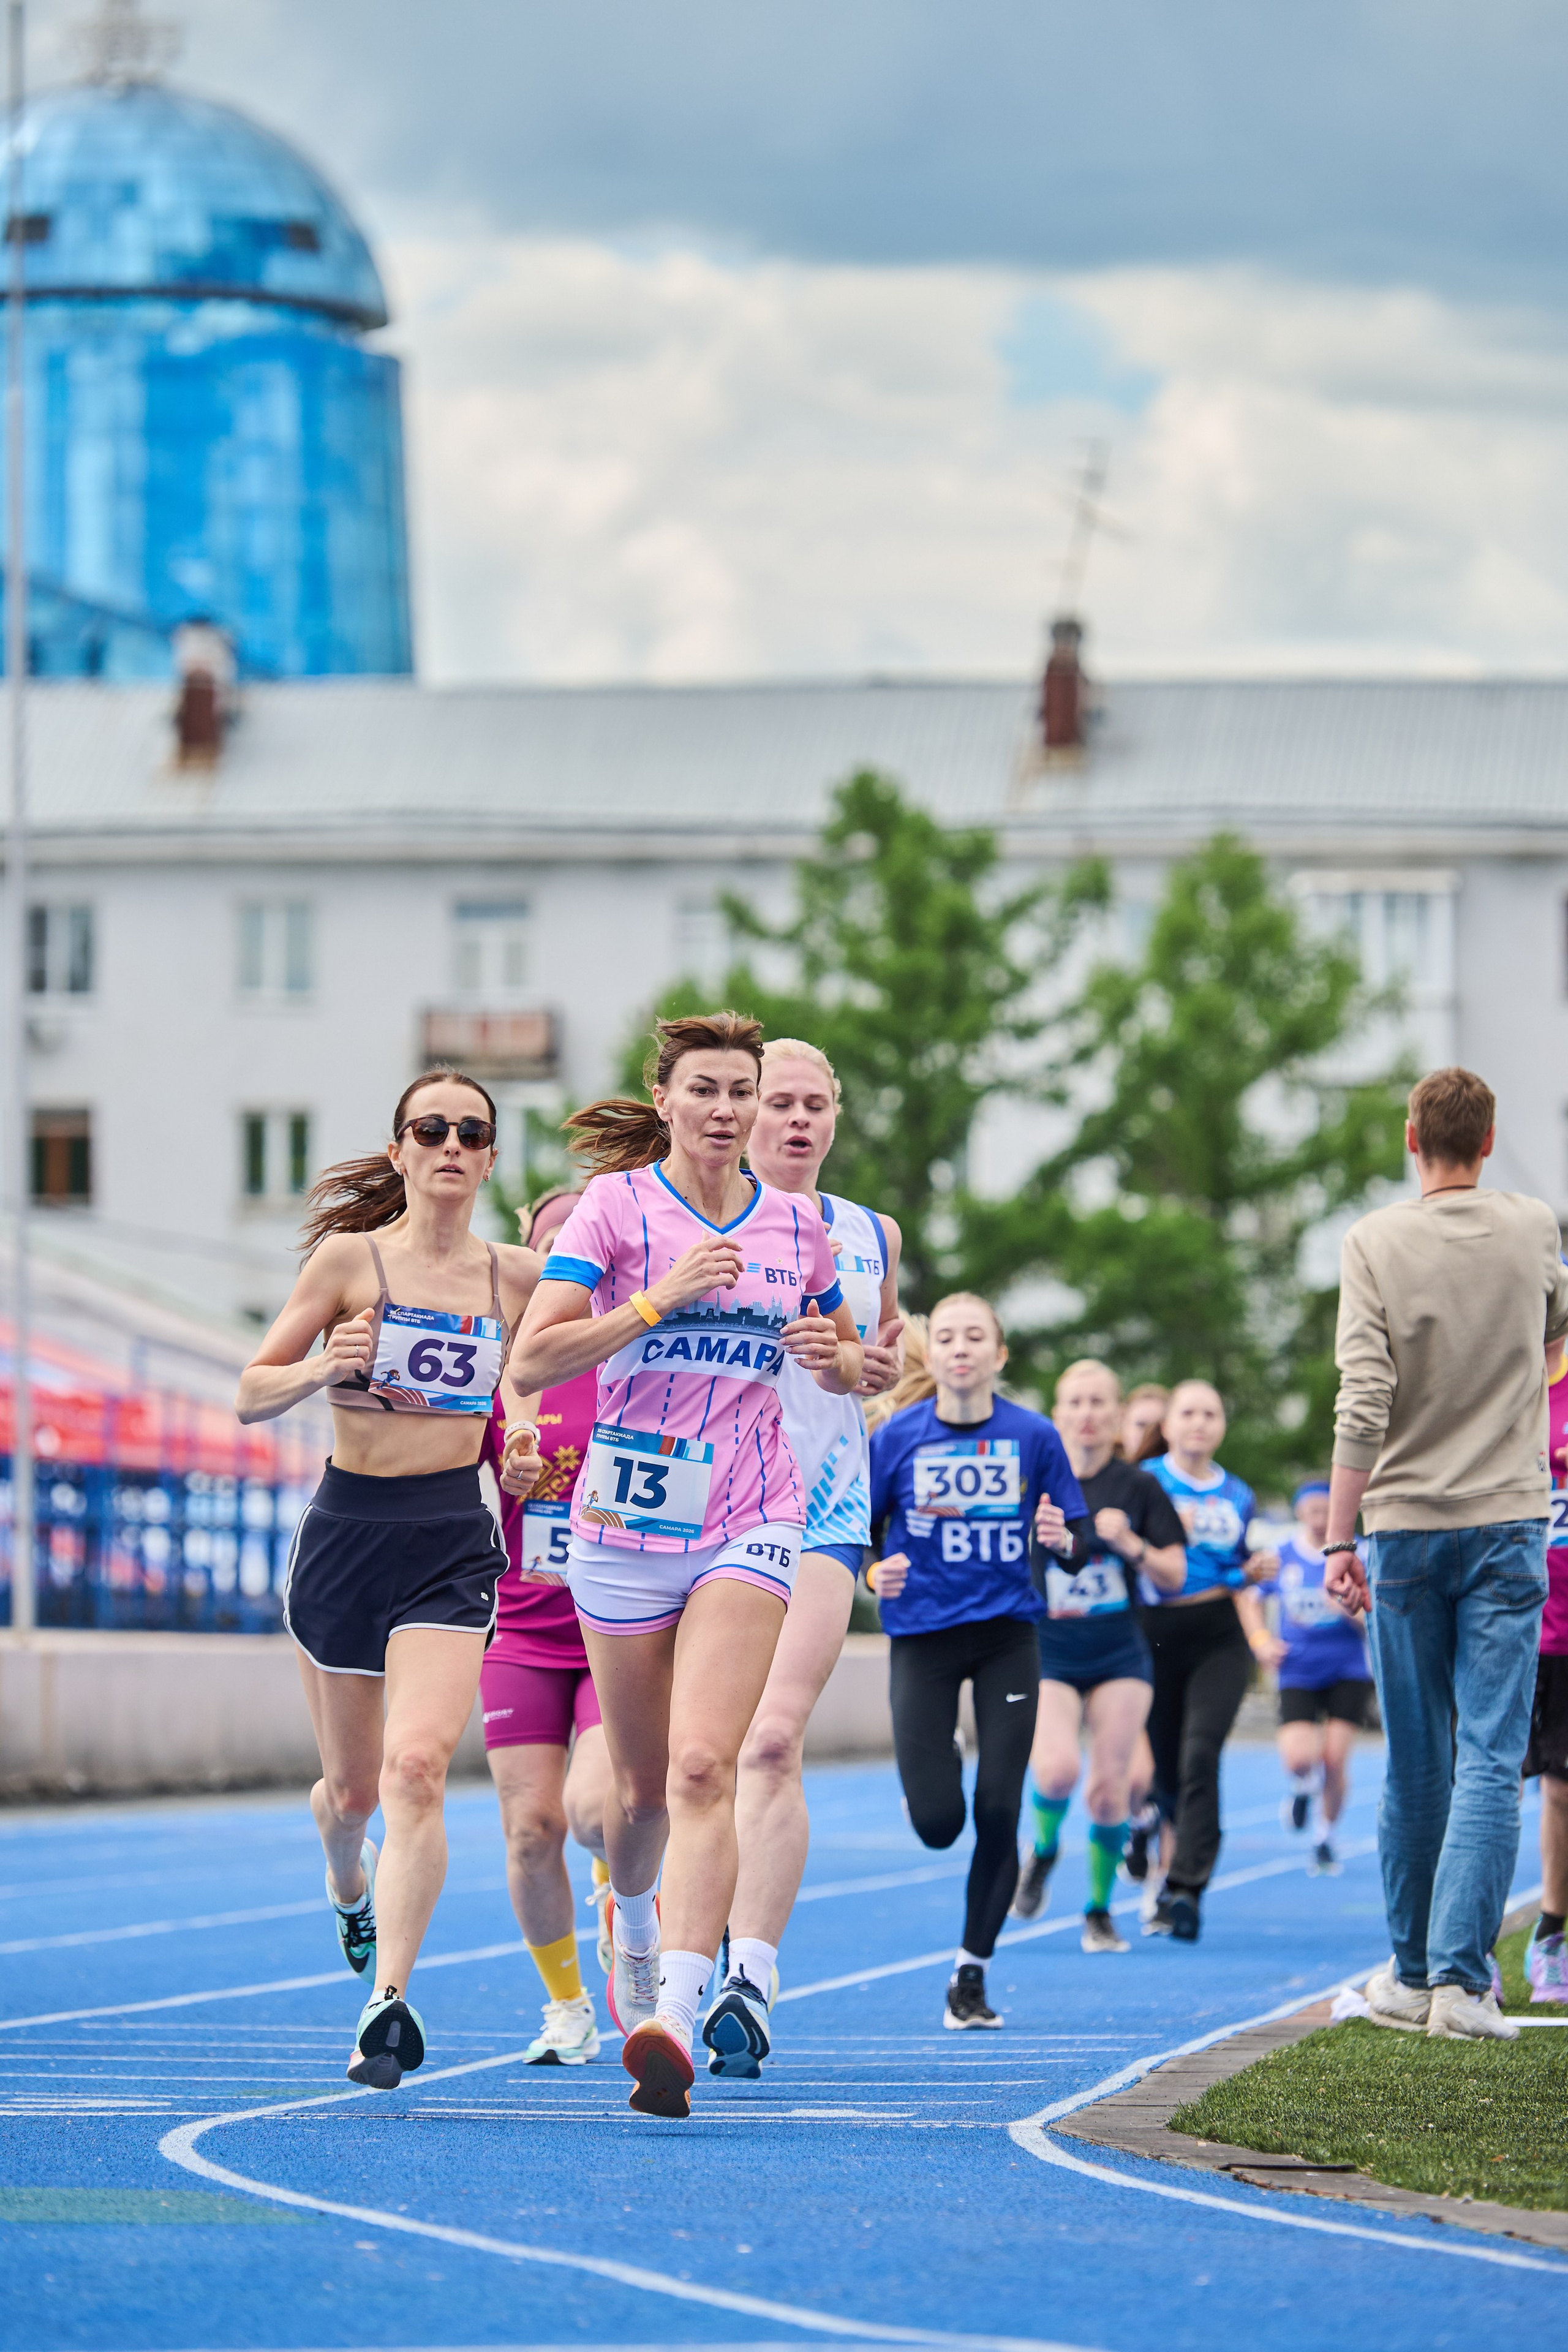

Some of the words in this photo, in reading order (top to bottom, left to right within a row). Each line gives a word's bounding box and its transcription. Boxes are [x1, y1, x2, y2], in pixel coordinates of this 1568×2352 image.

[765, 1267, 797, 1287] ВТБ
[862, 1259, 880, 1275] ТБ
[397, 1311, 434, 1321] СПАРТАКИАДА
[408, 1338, 477, 1387] 63
[642, 1336, 785, 1376] САМАРА
[602, 1429, 634, 1440] СПАРТАКИАДА
[613, 1456, 669, 1509] 13
[927, 1464, 1008, 1497] 303
[548, 1526, 571, 1564] 5
[746, 1543, 791, 1568] ВТБ
[941, 1520, 1024, 1562] ВТБ
